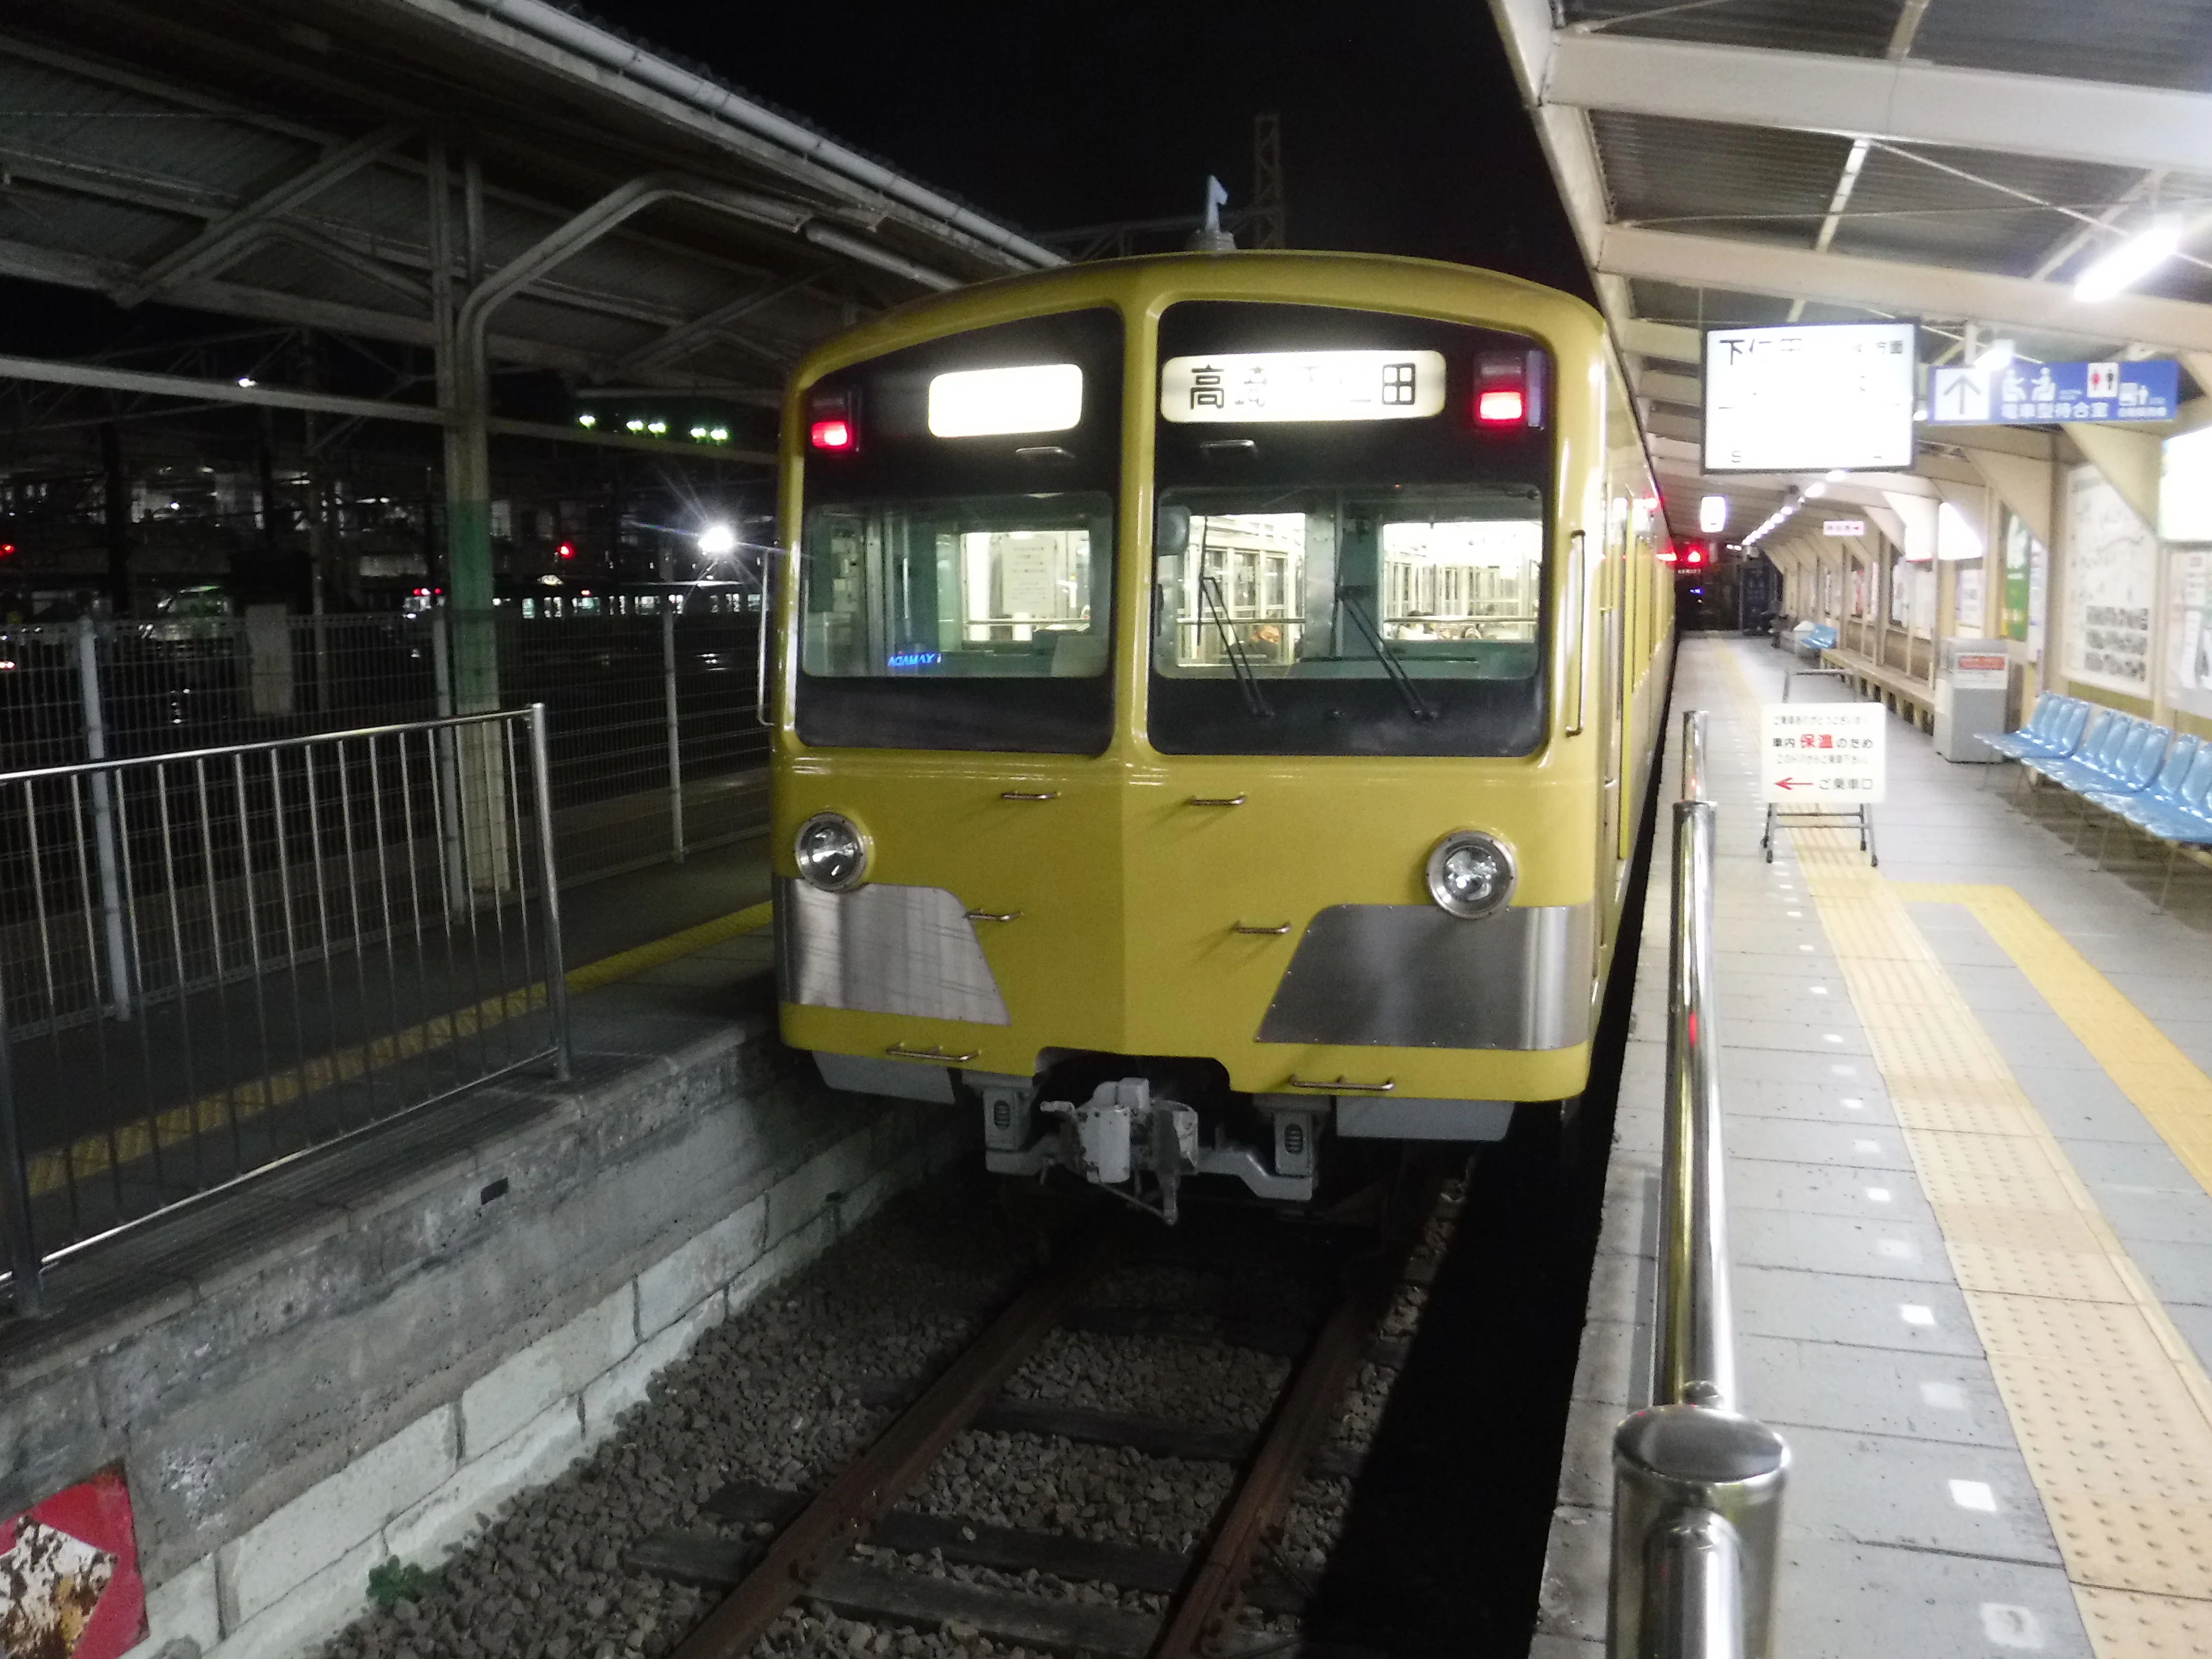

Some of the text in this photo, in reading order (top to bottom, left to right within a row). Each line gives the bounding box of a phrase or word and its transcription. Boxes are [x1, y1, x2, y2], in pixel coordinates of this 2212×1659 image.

[1773, 733, 1874, 749] 車内保温のため
[1819, 778, 1874, 790] ご乗車口
